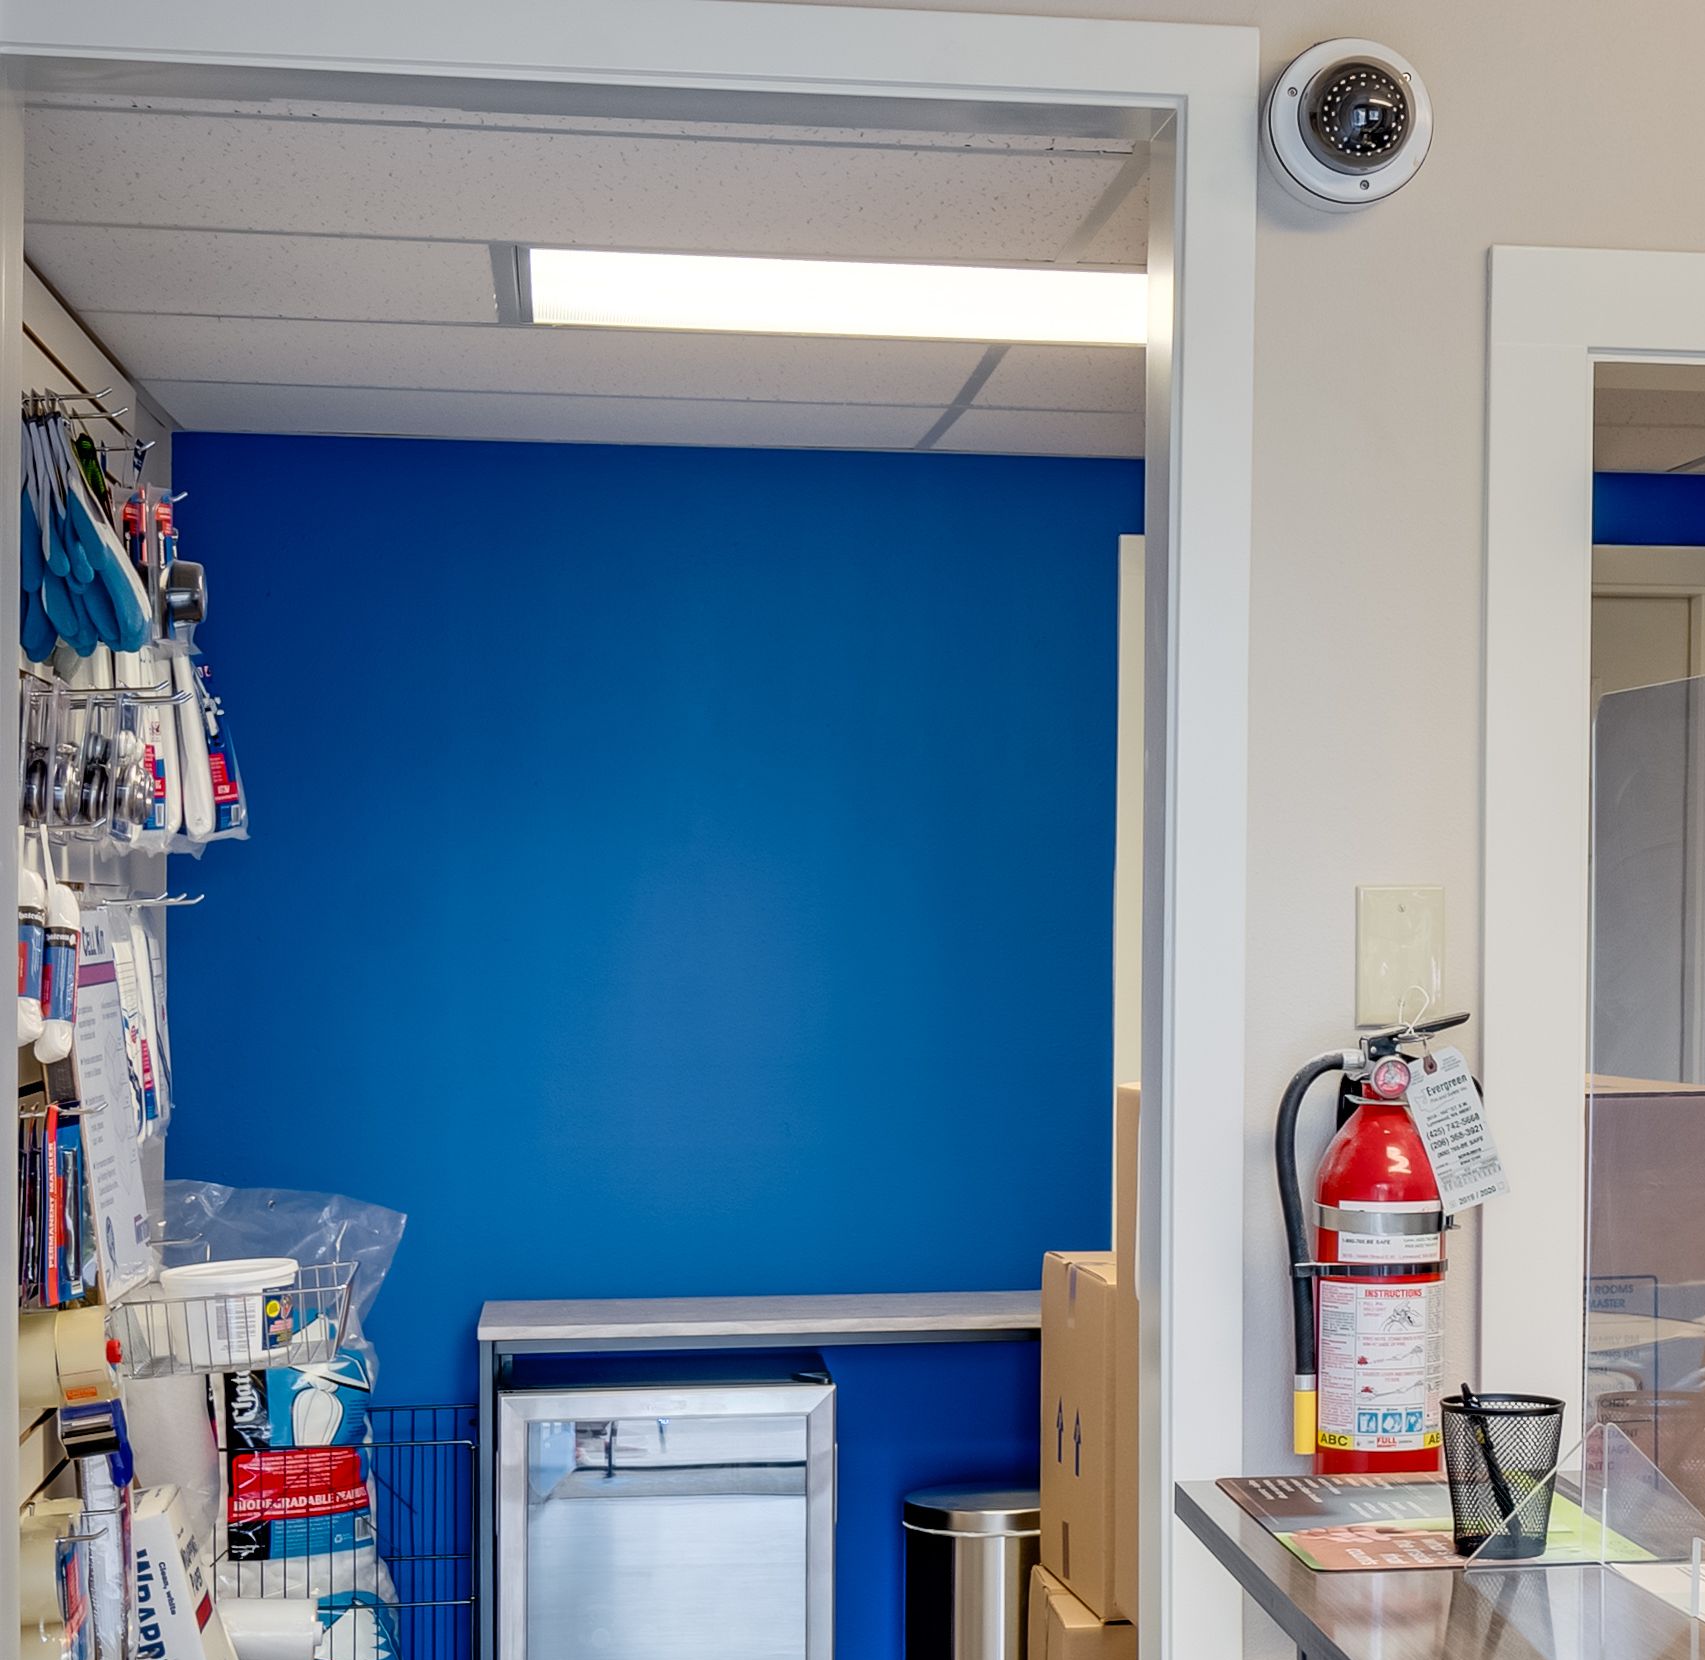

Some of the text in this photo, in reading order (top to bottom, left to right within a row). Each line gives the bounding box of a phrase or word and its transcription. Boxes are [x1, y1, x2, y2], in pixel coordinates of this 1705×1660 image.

[1426, 1074, 1468, 1097] Evergreen
[48, 1142, 56, 1268] PERMANENT MARKER
[1364, 1288, 1422, 1298] INSTRUCTIONS
[1595, 1284, 1634, 1295] ROOMS
[1320, 1432, 1441, 1447] ABC FULL AB
[158, 1561, 177, 1616] Clean, white
